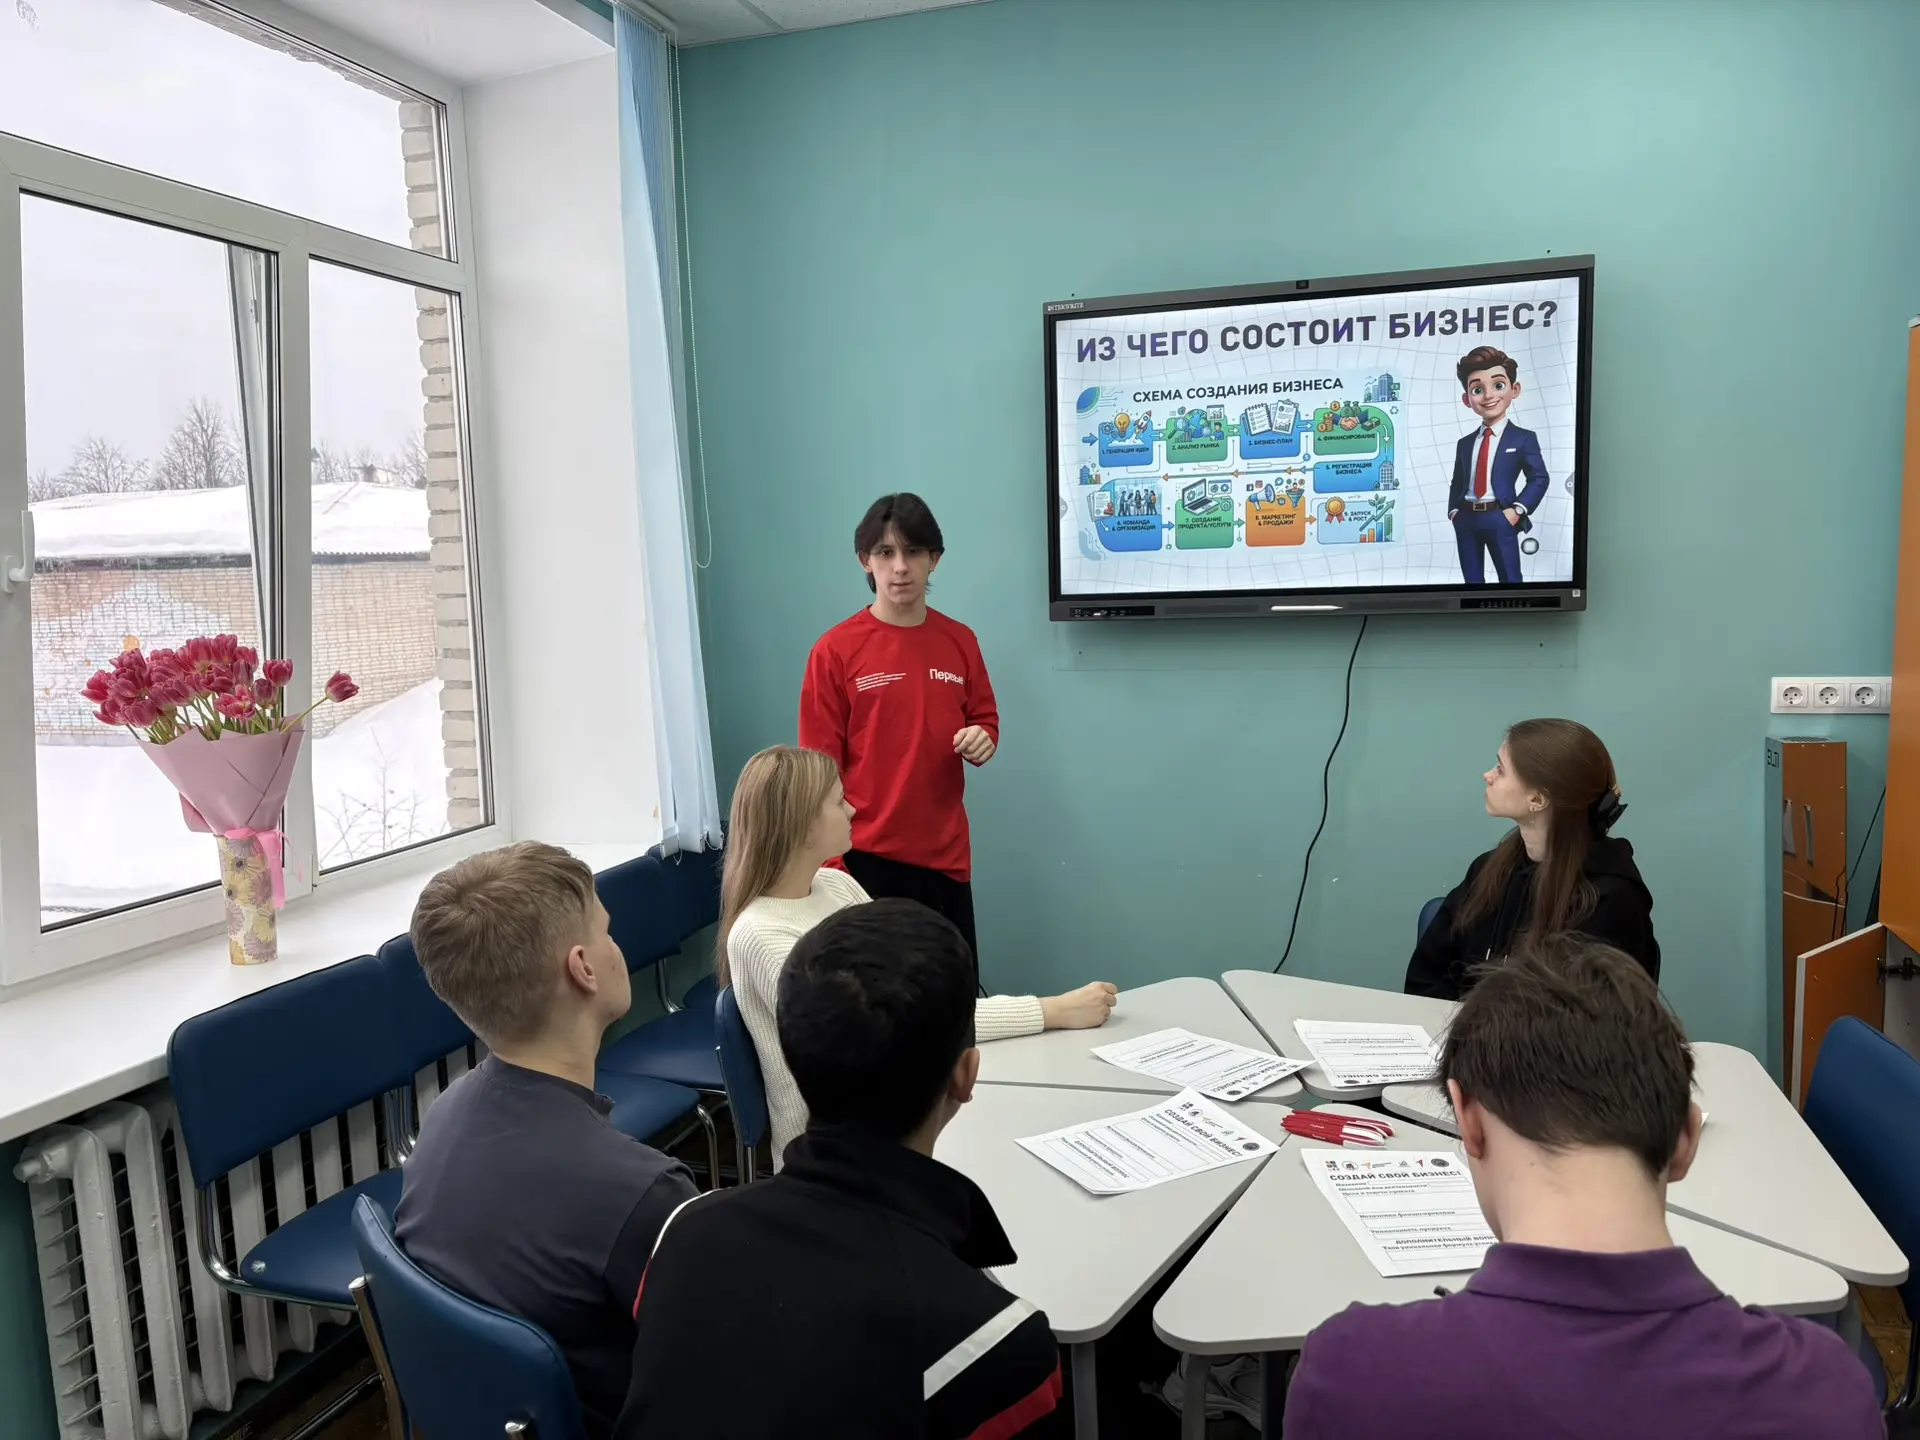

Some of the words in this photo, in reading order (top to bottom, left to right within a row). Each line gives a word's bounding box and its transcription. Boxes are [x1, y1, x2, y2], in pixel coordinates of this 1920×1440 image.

[1077, 335, 1116, 363] ИЗ
[1127, 328, 1209, 358] ЧЕГО
[1220, 315, 1377, 352] СОСТОИТ
[1388, 300, 1558, 340] БИЗНЕС?
[1132, 388, 1183, 403] СХЕМА
[1186, 382, 1269, 400] СОЗДАНИЯ
[1273, 377, 1344, 394] БИЗНЕСА
[1253, 438, 1293, 446] БИЗНЕС-ПЛАН
[1323, 433, 1376, 442] ФИНАНСИРОВАНИЕ
[1177, 522, 1232, 530] ПРОДУКТА/УСЛУГИ
[929, 668, 964, 685] Первые
[1164, 1108, 1194, 1127] СОЗДАЙ
[1190, 1123, 1213, 1139] СВОЙ
[1209, 1137, 1244, 1158] БИЗНЕС!
[1329, 1172, 1376, 1181] СОЗДАЙ
[1378, 1171, 1410, 1179] СВОЙ
[1411, 1170, 1462, 1178] БИЗНЕС!
